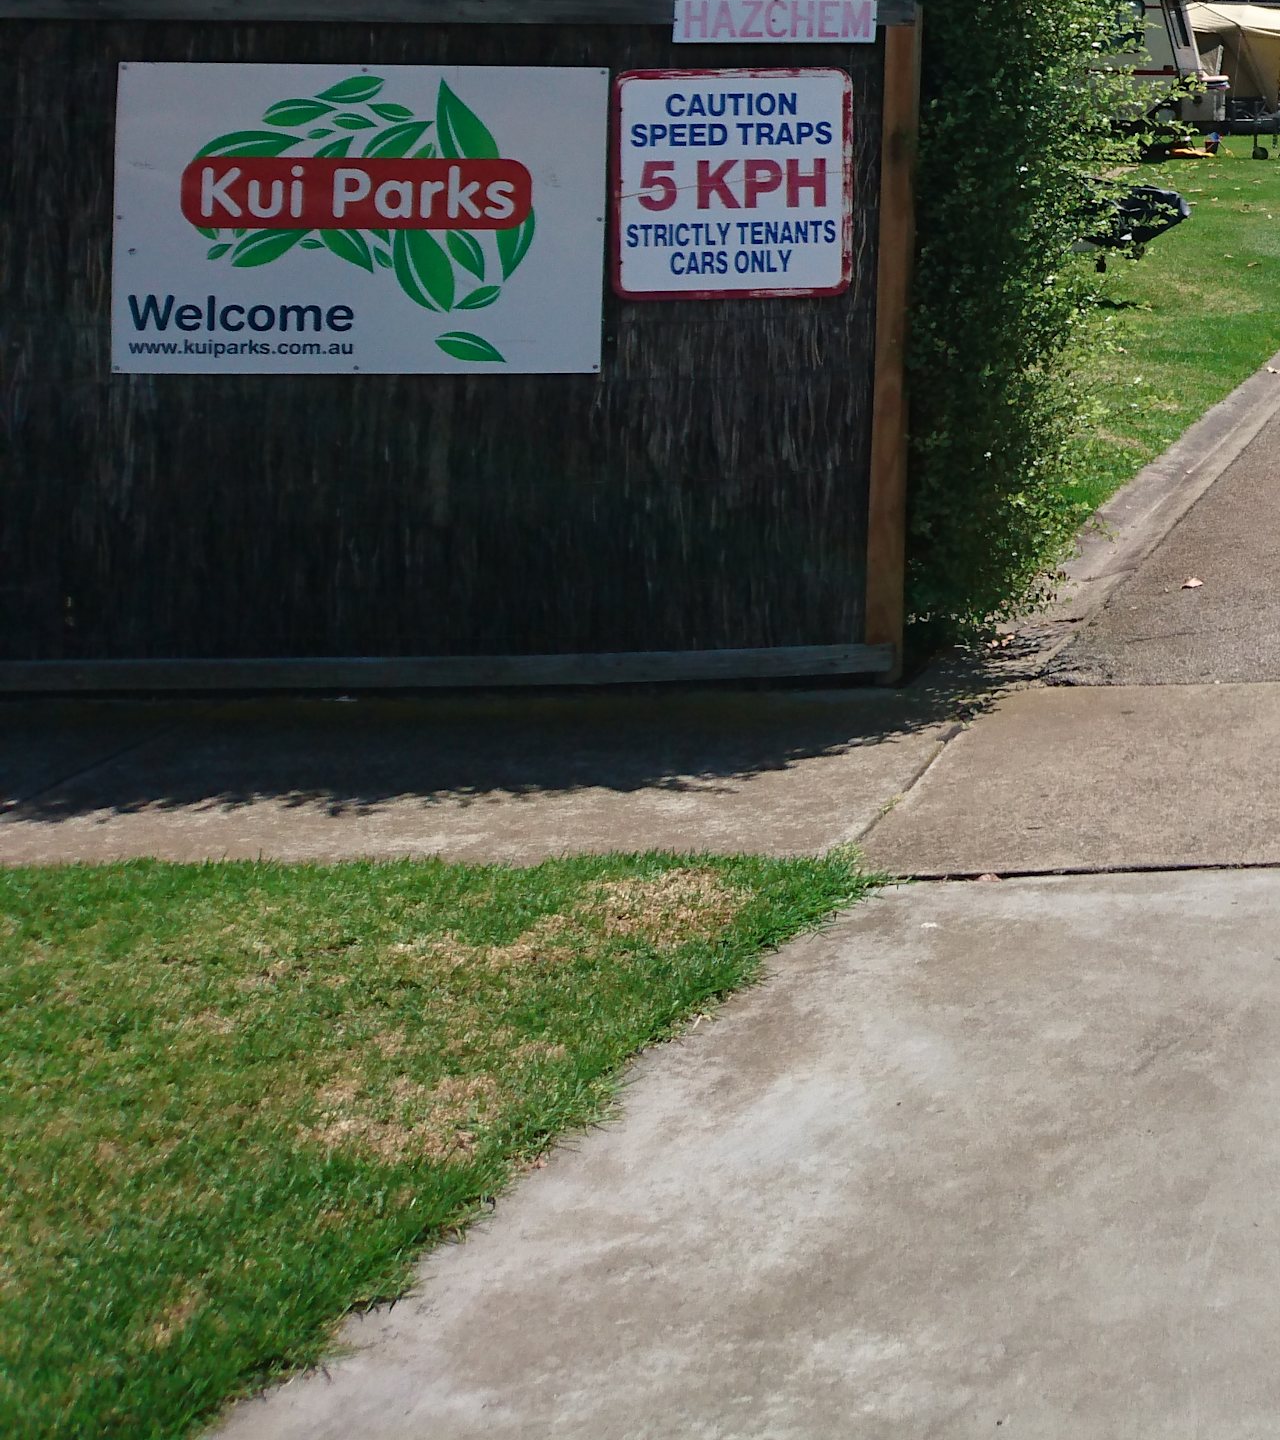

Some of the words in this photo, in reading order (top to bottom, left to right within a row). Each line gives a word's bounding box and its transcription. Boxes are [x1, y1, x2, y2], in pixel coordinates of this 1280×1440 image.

[684, 0, 871, 39] HAZCHEM
[666, 93, 797, 116] CAUTION
[631, 124, 727, 147] SPEED
[737, 122, 832, 145] TRAPS
[201, 166, 304, 219] Kui
[332, 166, 515, 220] Parks
[638, 161, 676, 211] 5
[696, 158, 827, 209] KPH
[626, 223, 731, 247] STRICTLY
[737, 220, 836, 244] TENANTS
[670, 252, 727, 275] CARS
[734, 250, 792, 274] ONLY
[128, 294, 354, 332] Welcome
[129, 339, 353, 358] www.kuiparks.com.au
